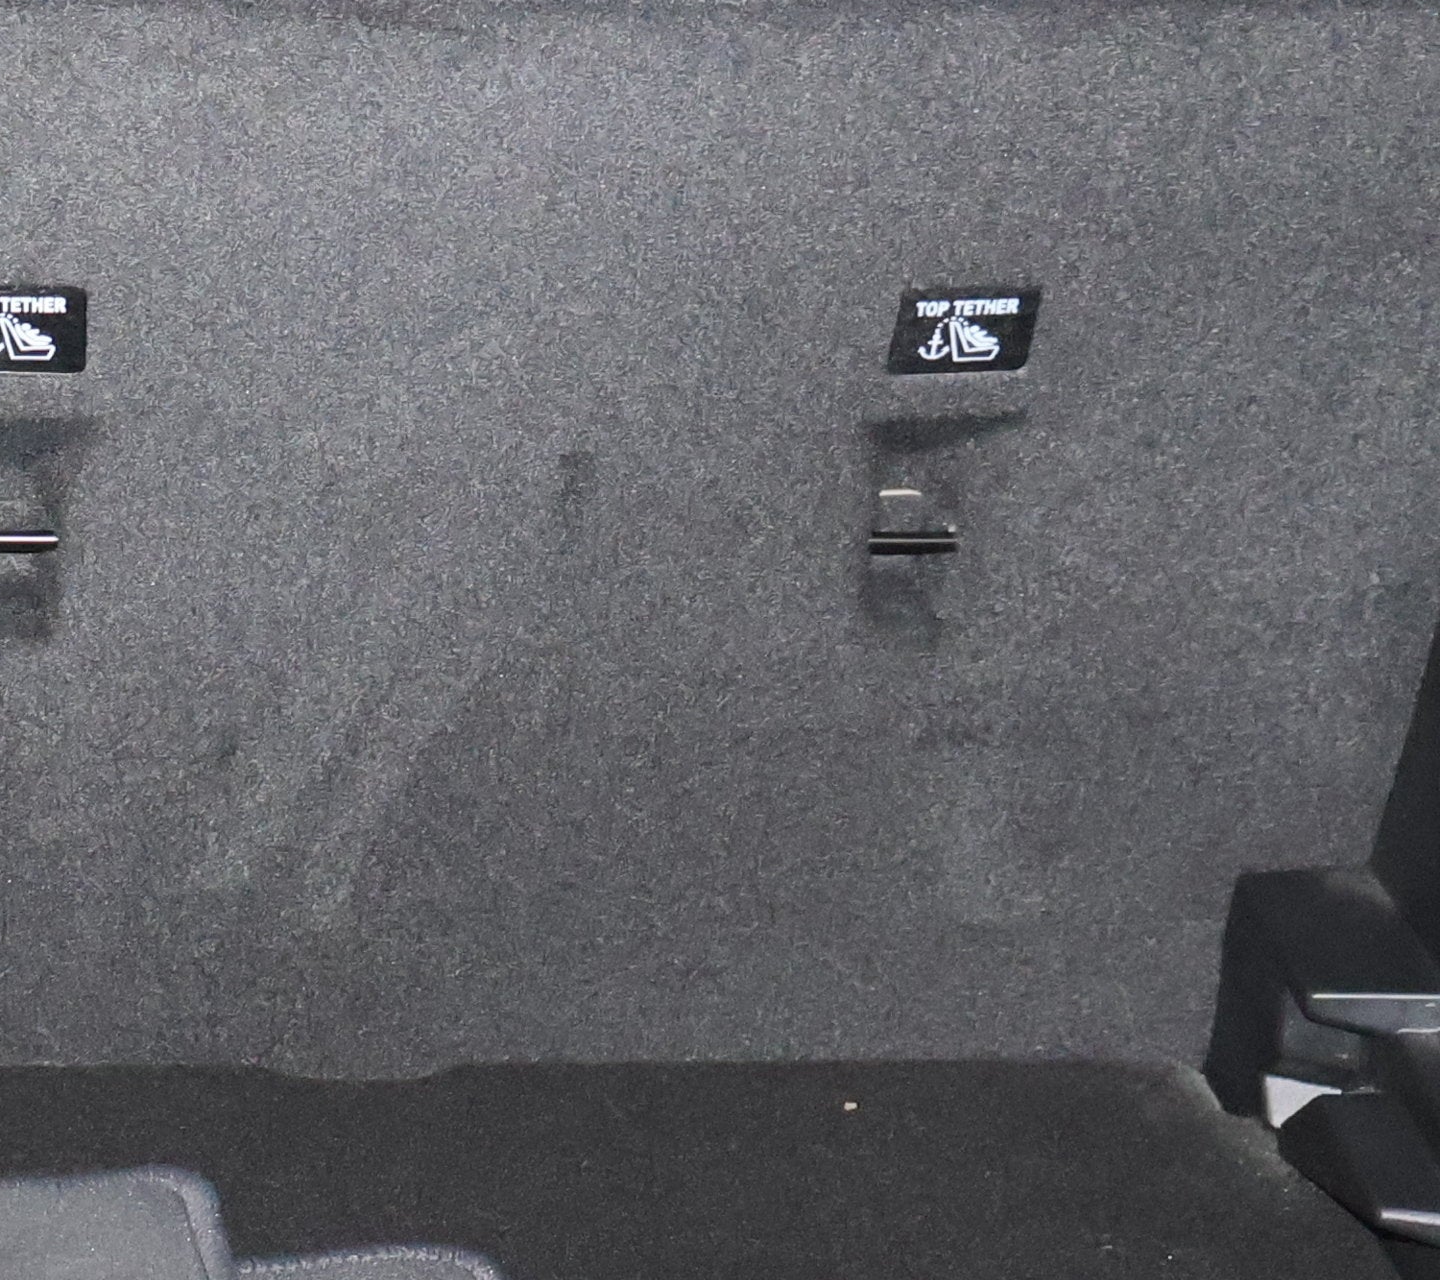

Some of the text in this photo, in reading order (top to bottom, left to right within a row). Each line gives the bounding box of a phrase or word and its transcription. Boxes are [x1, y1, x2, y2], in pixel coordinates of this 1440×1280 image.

[0, 296, 67, 313] TETHER
[916, 298, 1019, 317] TOP TETHER
